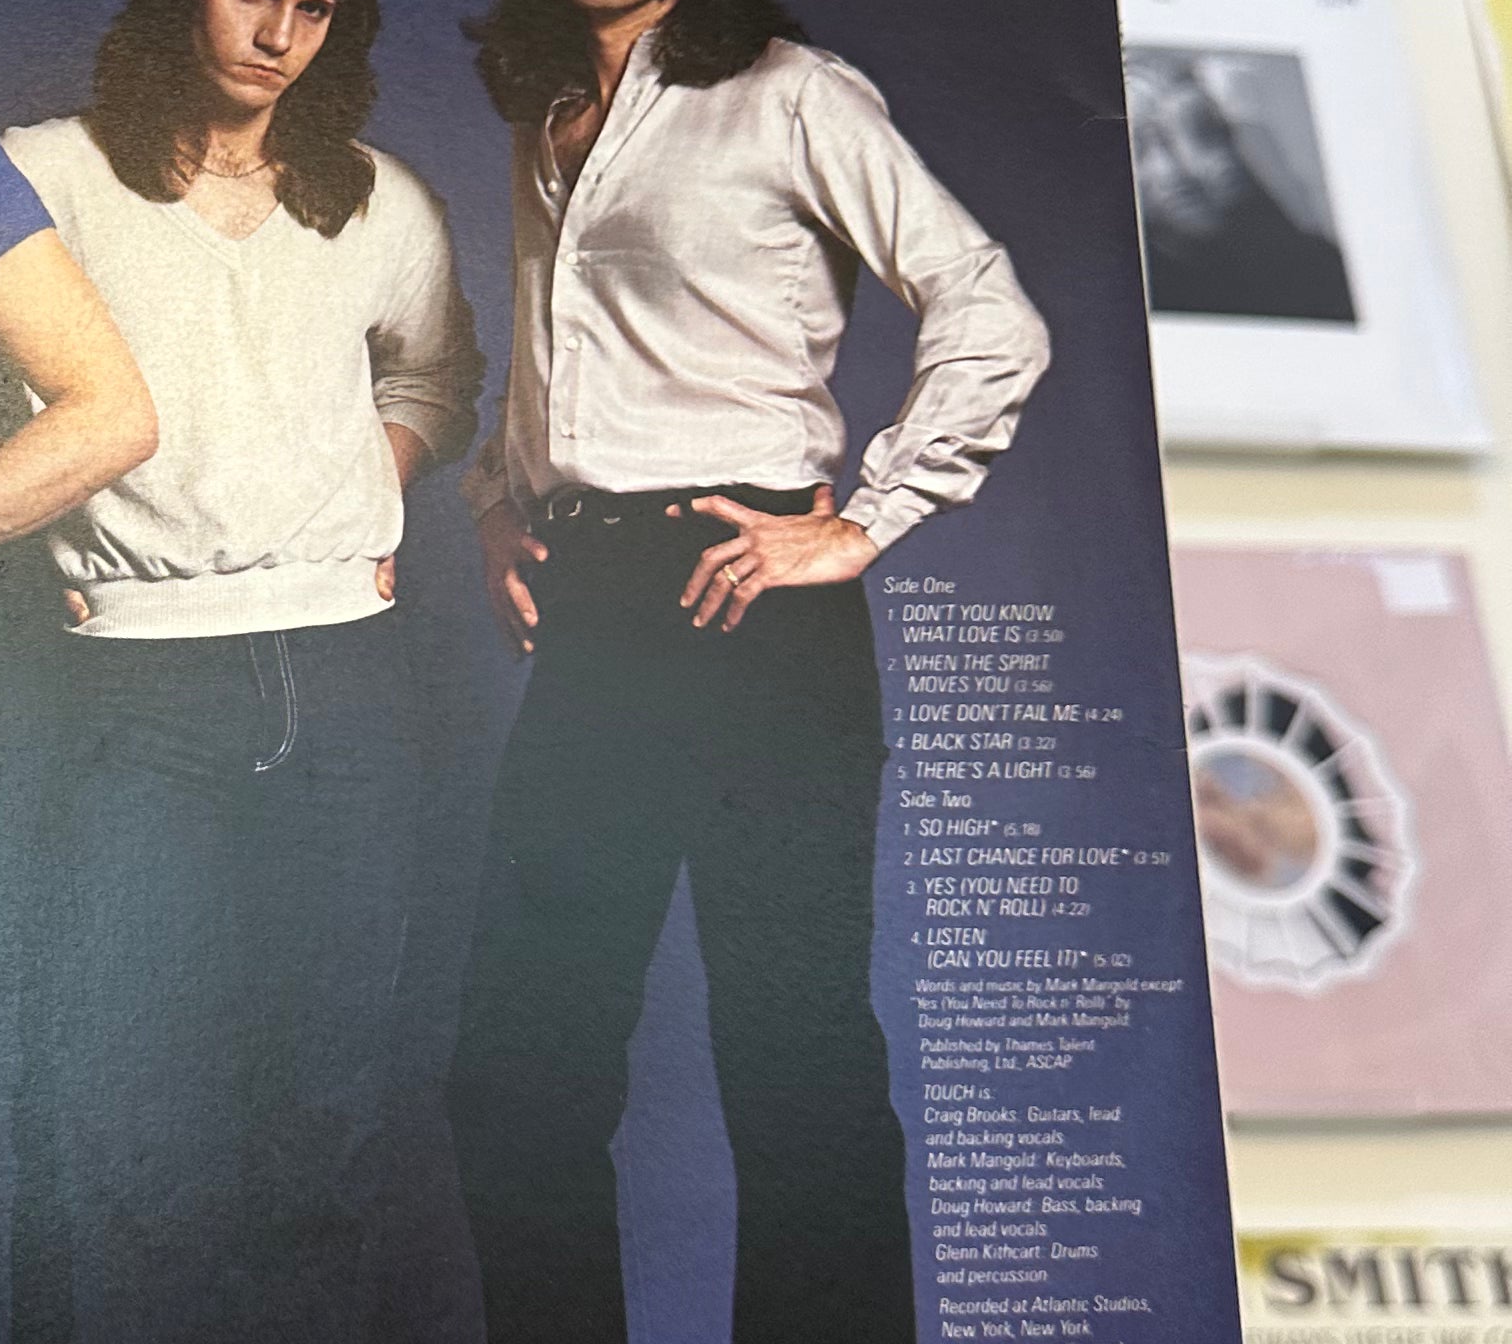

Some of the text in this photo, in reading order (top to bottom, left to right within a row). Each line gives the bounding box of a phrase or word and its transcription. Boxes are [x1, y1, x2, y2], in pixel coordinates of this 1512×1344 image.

[884, 577, 955, 595] Side One
[902, 605, 1054, 621] DON'T YOU KNOW
[902, 627, 1021, 642] WHAT LOVE IS
[904, 655, 1049, 671] WHEN THE SPIRIT
[908, 677, 1009, 692] MOVES YOU
[910, 705, 1080, 721] LOVE DON'T FAIL ME
[911, 733, 1012, 749] BLACK STAR
[916, 762, 1051, 778] THERE'S A LIGHT
[900, 791, 971, 808] Side Two
[919, 819, 942, 836] SO
[920, 849, 962, 865] LAST
[967, 848, 1036, 865] CHANCE
[1041, 848, 1074, 864] FOR
[924, 877, 1078, 894] YES (YOU NEED TO
[925, 899, 971, 916] ROCK
[1000, 899, 1046, 916] ROLL)
[927, 928, 985, 945] LISTEN
[928, 951, 970, 969] (CAN
[976, 951, 1011, 967] YOU
[1015, 951, 1052, 967] FEEL
[925, 1084, 974, 1100] TOUCH
[925, 1108, 962, 1125] Craig
[1089, 1107, 1121, 1121] lead
[926, 1130, 1064, 1148] and backing vocals
[936, 1244, 977, 1260] Glenn
[1050, 1243, 1098, 1258] Drums
[937, 1268, 1047, 1286] and percussion
[940, 1298, 1009, 1314] Recorded
[1012, 1299, 1027, 1313] at
[1031, 1297, 1088, 1313] Atlantic
